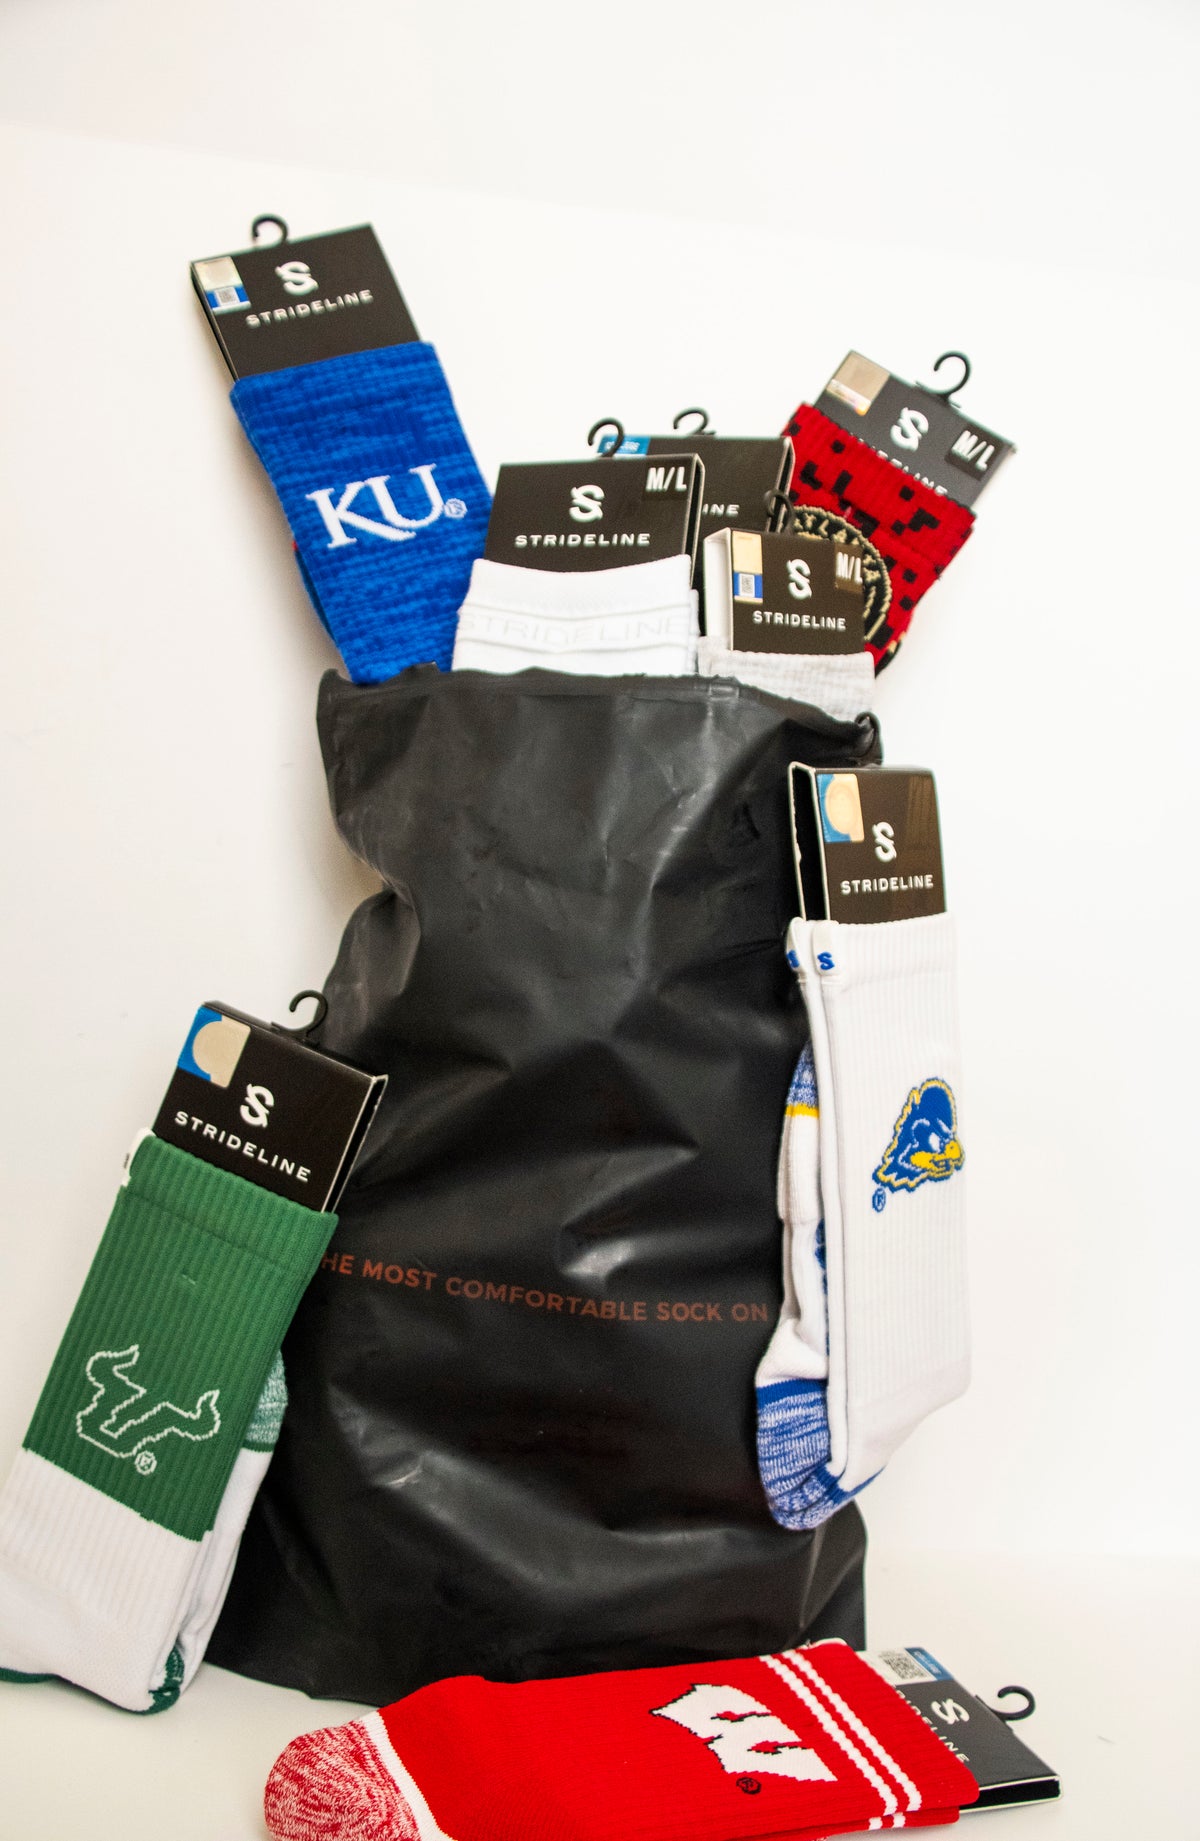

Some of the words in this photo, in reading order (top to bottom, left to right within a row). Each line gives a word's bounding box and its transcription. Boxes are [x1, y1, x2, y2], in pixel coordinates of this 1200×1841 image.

[245, 289, 374, 329] STRIDELINE
[951, 430, 995, 471] M/L
[645, 466, 687, 492] M/L
[514, 533, 650, 548] STRIDELINE
[836, 552, 863, 584] M/L
[753, 610, 847, 631] STRIDELINE
[840, 874, 934, 895] STRIDELINE
[174, 1111, 311, 1183] STRIDELINE
[362, 1259, 438, 1290] MOST
[445, 1277, 647, 1321] COMFORTABLE
[656, 1301, 722, 1321] SOCK
[731, 1303, 768, 1322] ON
